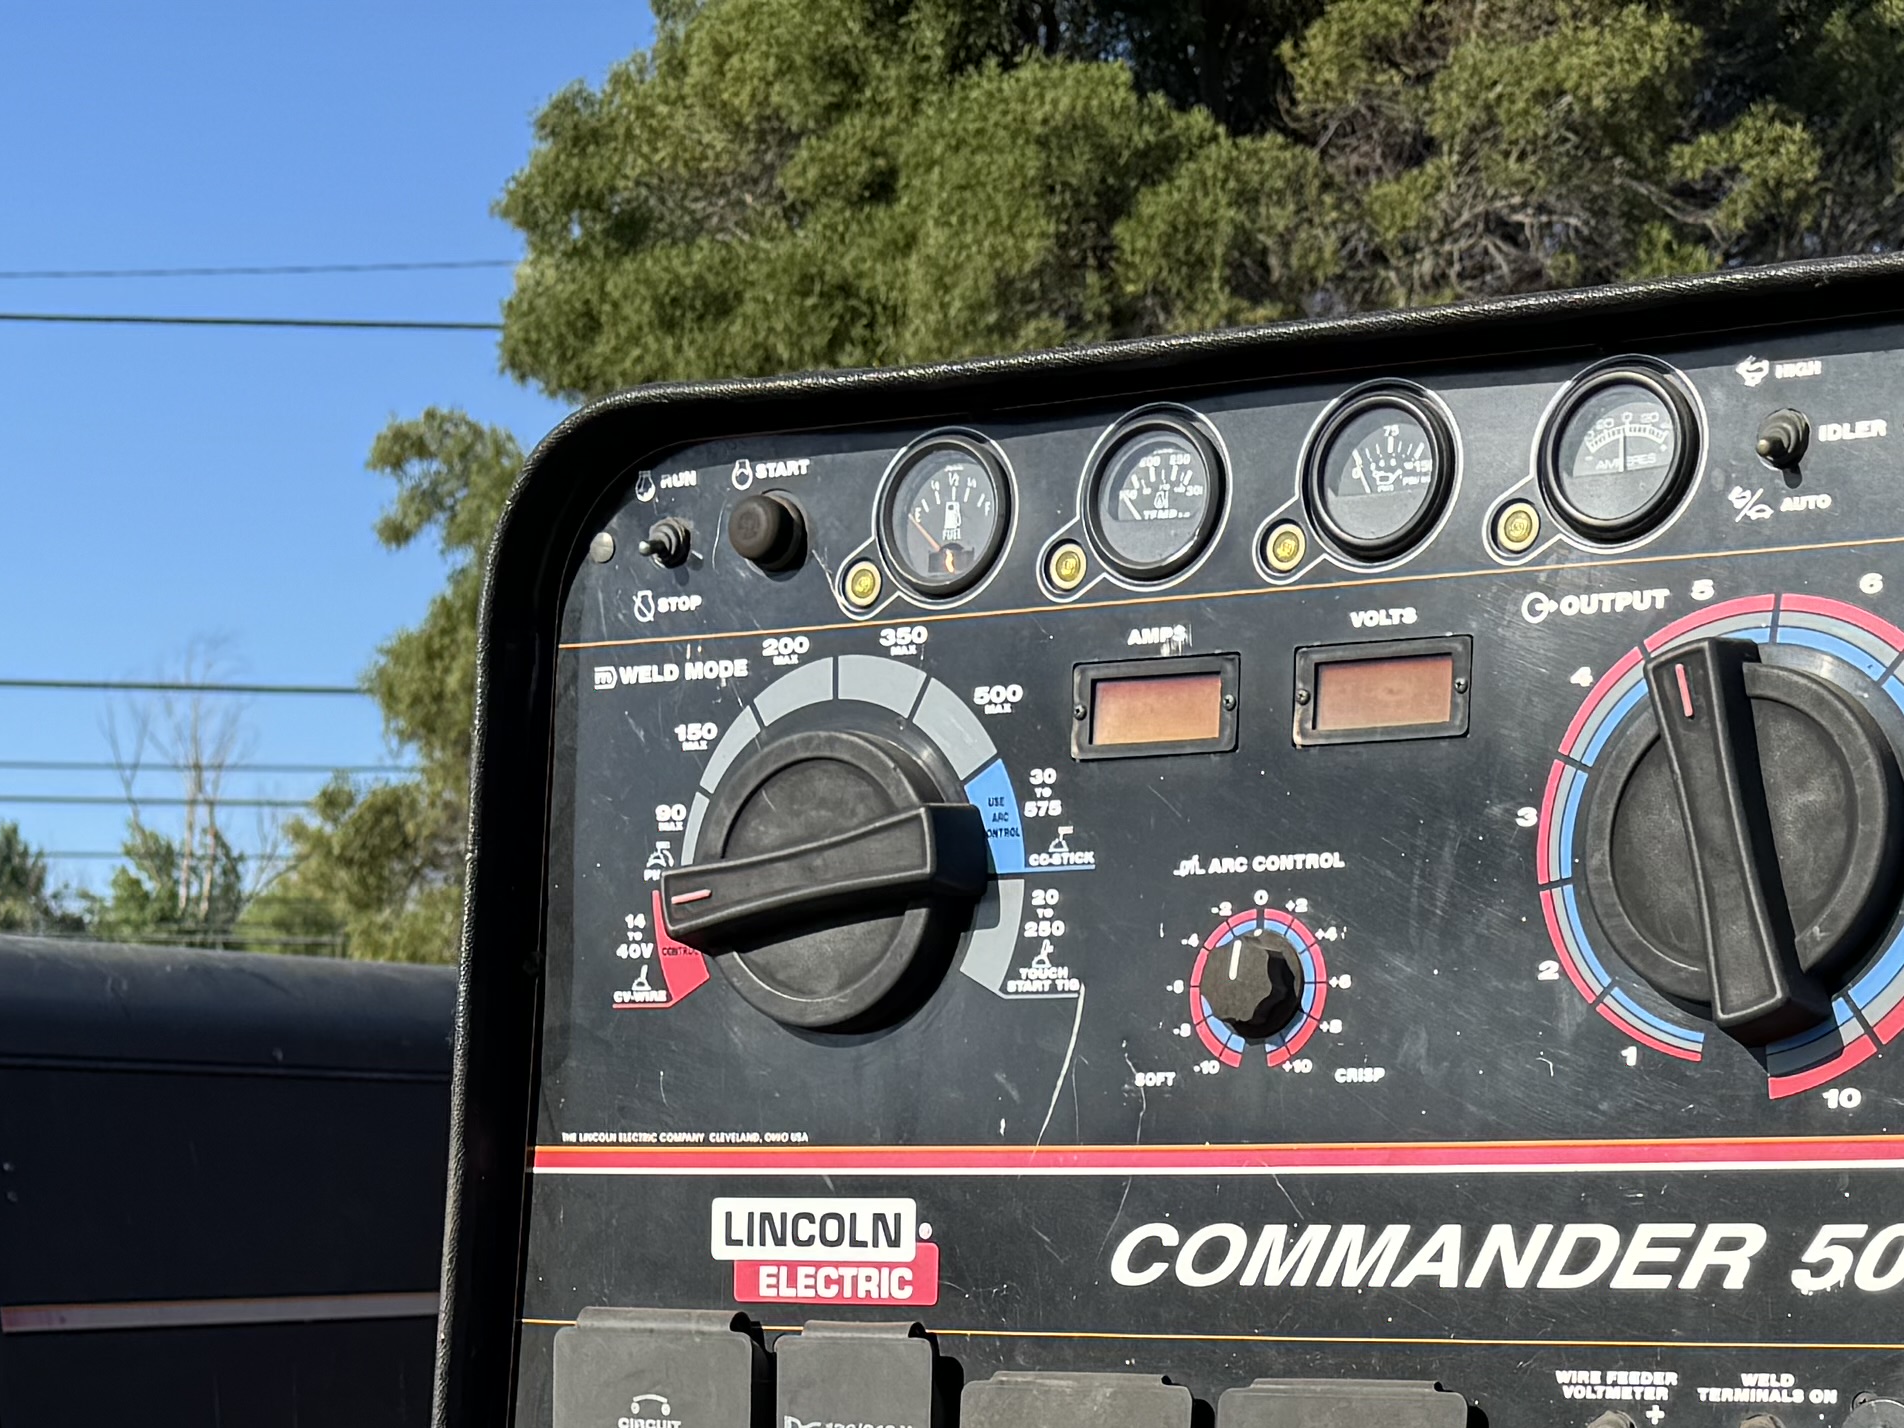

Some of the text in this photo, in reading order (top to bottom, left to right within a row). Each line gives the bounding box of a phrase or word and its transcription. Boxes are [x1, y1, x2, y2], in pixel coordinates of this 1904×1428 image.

[1775, 361, 1822, 378] HIGH
[1818, 419, 1887, 442] IDLER
[755, 459, 811, 479] START
[660, 470, 697, 488] RUN
[1780, 494, 1832, 511] AUTO
[1691, 579, 1714, 600] 5
[1860, 572, 1883, 595] 6
[658, 595, 703, 612] STOP
[1559, 587, 1670, 616] OUTPUT
[1350, 607, 1417, 629] VOLTS
[879, 625, 928, 647] 350
[1127, 625, 1186, 646] AMPS
[762, 636, 810, 657] 200
[890, 645, 918, 656] MAX
[773, 654, 799, 665] MAX
[619, 659, 748, 684] WELD MODE
[1570, 667, 1594, 688] 4
[973, 684, 1024, 705] 500
[984, 702, 1012, 714] MAX
[674, 721, 719, 741] 150
[682, 739, 709, 751] MAX
[1029, 768, 1057, 785] 30
[655, 804, 687, 822] 90
[1023, 800, 1062, 817] 575
[1516, 808, 1537, 828] 3
[1208, 852, 1345, 875] ARC CONTROL
[1031, 889, 1060, 906] 20
[1254, 889, 1269, 906] 0
[1285, 897, 1309, 914] +2
[1211, 901, 1232, 917] -2
[625, 913, 646, 930] 14
[1024, 920, 1066, 938] 250
[1181, 933, 1199, 948] -4
[1315, 926, 1338, 941] +4
[616, 943, 654, 960] 40V
[1019, 967, 1069, 980] TOUCH
[1538, 961, 1560, 981] 2
[1007, 980, 1052, 992] START
[1622, 1046, 1637, 1067] 1
[1193, 1060, 1220, 1075] -10
[1282, 1059, 1313, 1073] +10
[1135, 1071, 1176, 1087] SOFT
[1334, 1067, 1385, 1084] CRISP
[1822, 1087, 1861, 1109] 10
[724, 1211, 902, 1248] LINCOLN
[1108, 1221, 1767, 1290] COMMANDER
[758, 1266, 914, 1299] ELECTRIC
[1555, 1370, 1679, 1388] WIRE FEEDER
[1741, 1373, 1795, 1388] WELD
[1562, 1384, 1670, 1401] VOLTMETER
[1697, 1387, 1838, 1404] TERMINALS ON
